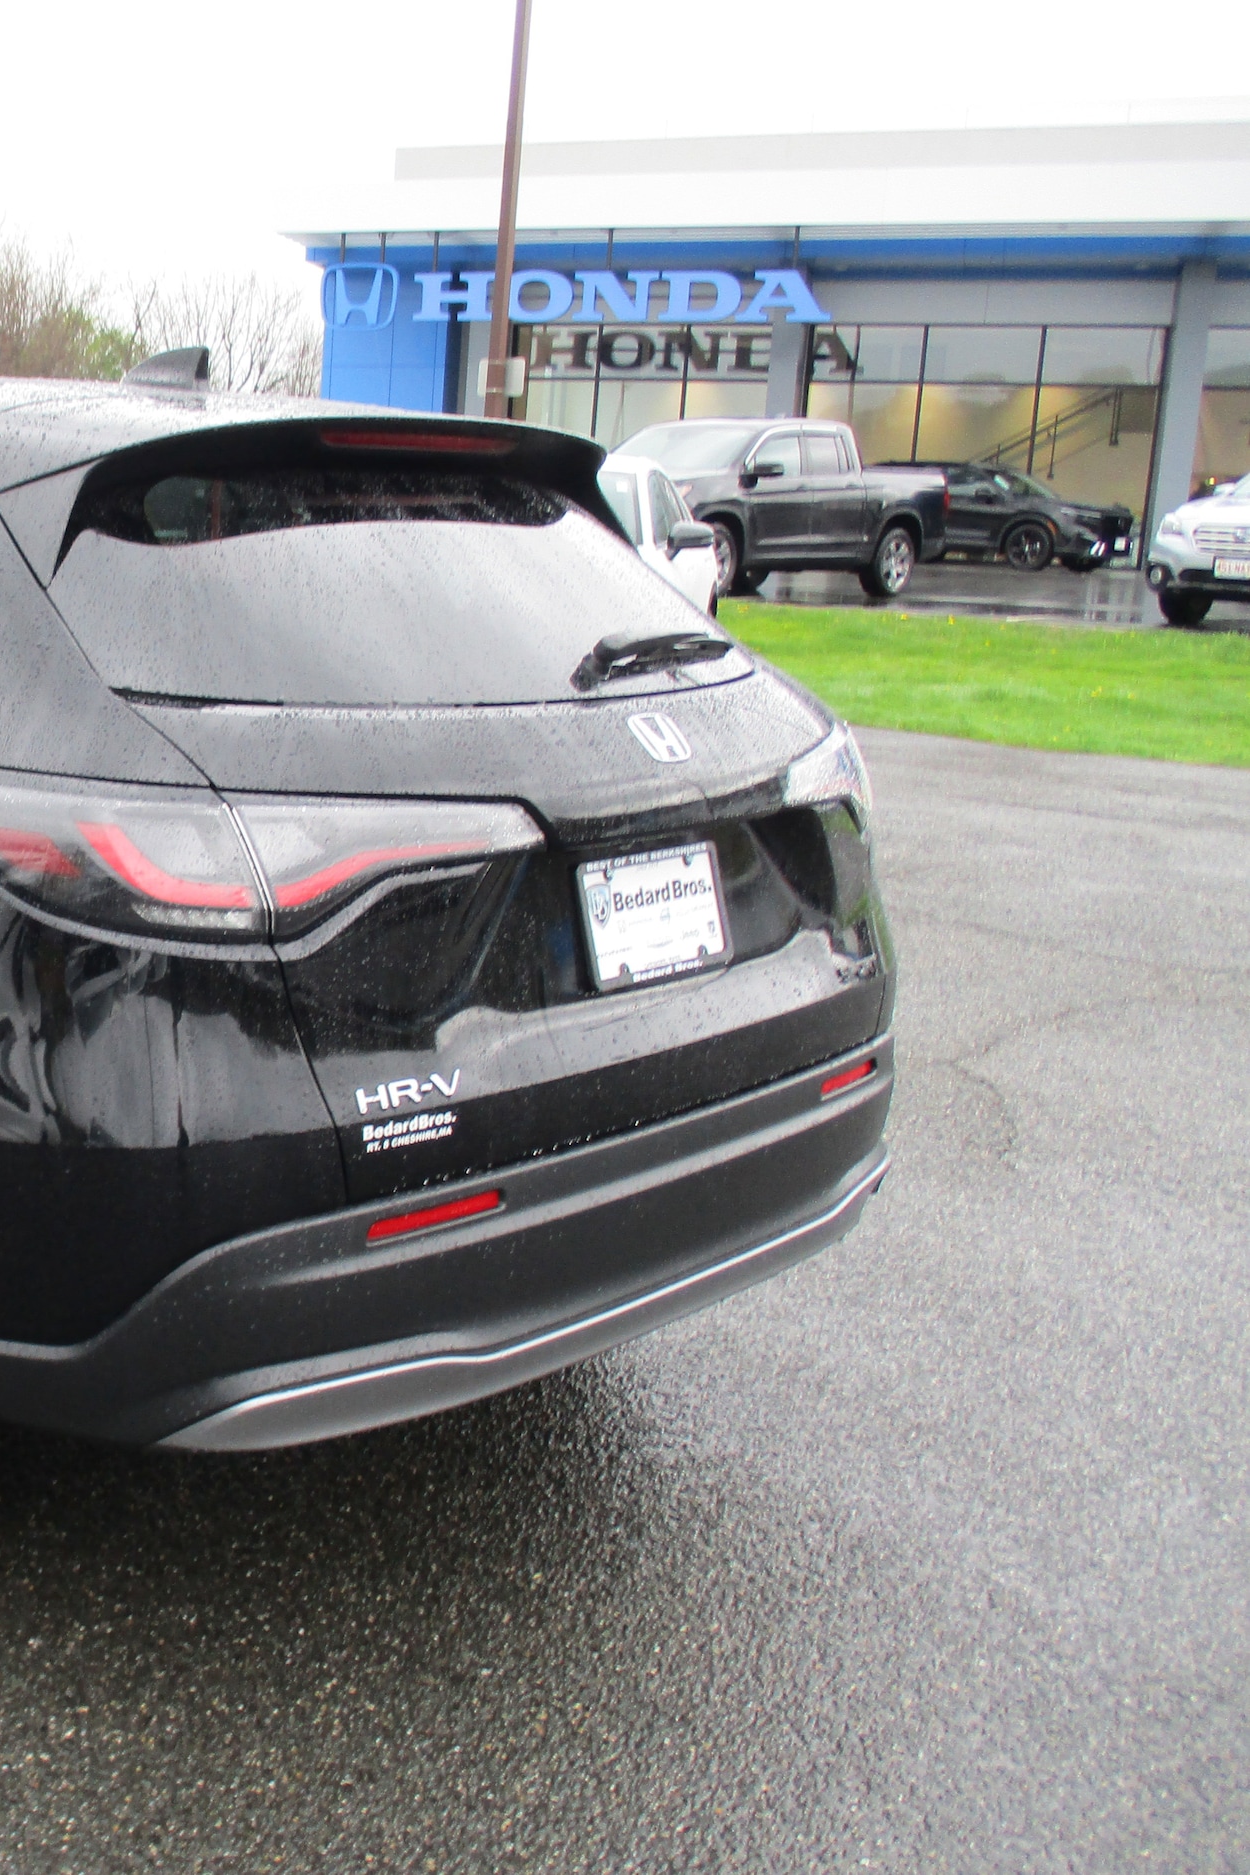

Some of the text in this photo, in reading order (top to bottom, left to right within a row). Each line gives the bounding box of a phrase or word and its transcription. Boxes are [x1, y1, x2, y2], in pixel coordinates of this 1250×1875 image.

[412, 268, 832, 323] HONDA
[586, 859, 613, 873] BEST
[614, 856, 628, 867] OF
[630, 852, 649, 864] THE
[650, 842, 707, 861] BERKSHIRES
[632, 964, 672, 983] Bedard
[355, 1068, 460, 1114] HR-V
